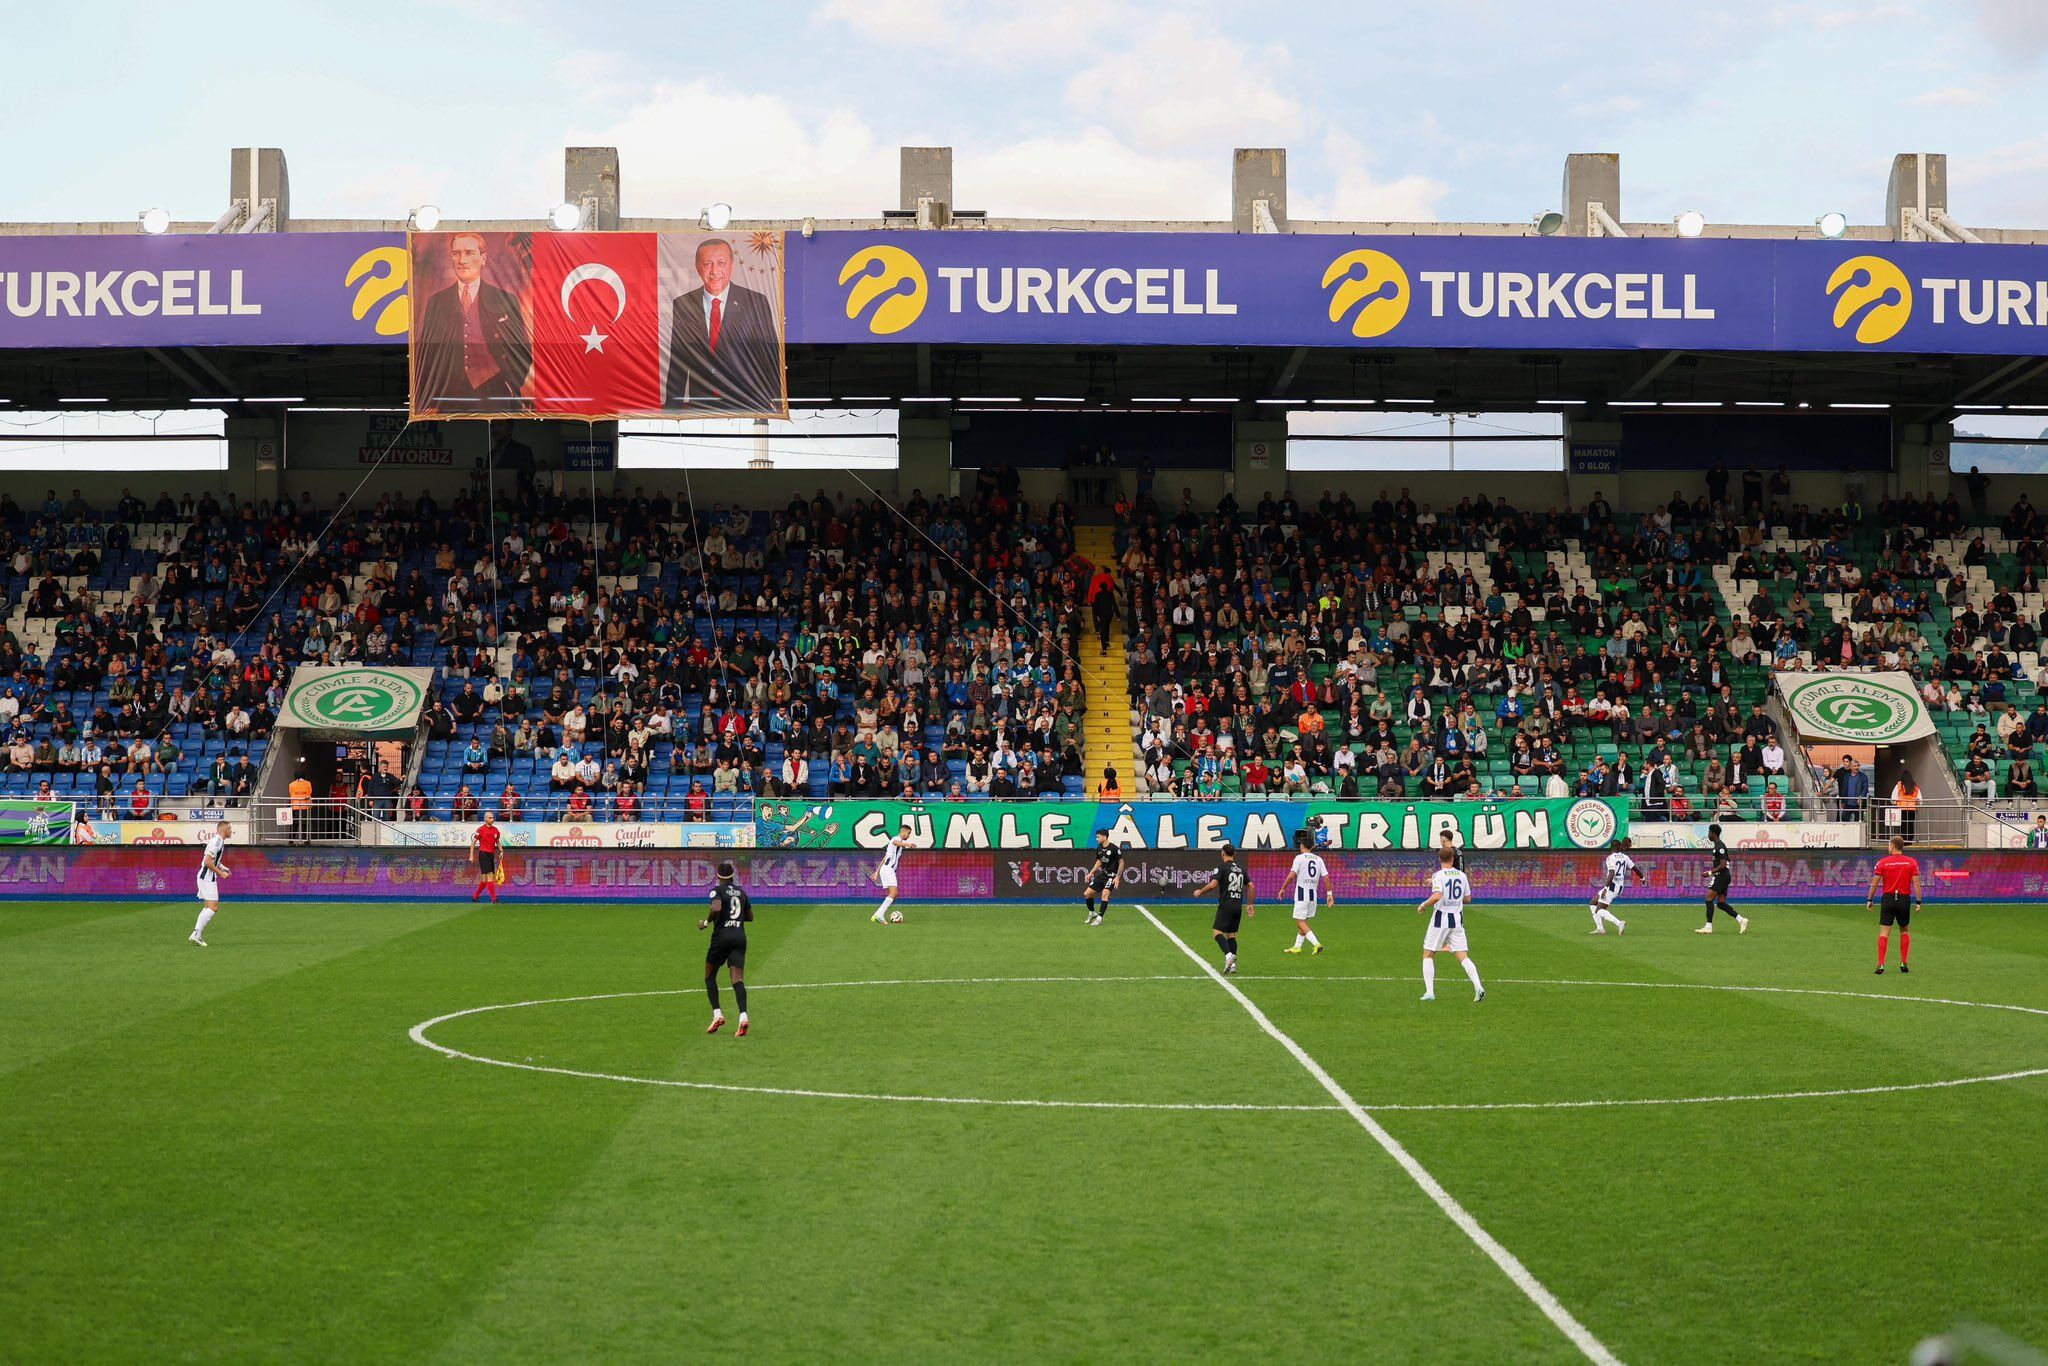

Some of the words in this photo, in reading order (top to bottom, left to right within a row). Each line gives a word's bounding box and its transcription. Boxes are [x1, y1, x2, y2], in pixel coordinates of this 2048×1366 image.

[0, 269, 262, 317] URKCELL
[938, 267, 1238, 315] TURKCELL
[1420, 271, 1716, 319] TURKCELL
[1921, 278, 2048, 326] TUR
[567, 446, 609, 454] MARATON
[1573, 449, 1616, 457] MARATON
[572, 459, 578, 467] C
[581, 459, 605, 467] BLOK
[1588, 462, 1611, 470] BLOK
[281, 811, 288, 821] 8
[854, 805, 1074, 849] CÜMLE
[1107, 802, 1287, 849] ÂLEM
[1320, 805, 1550, 850] TRİBÜN
[512, 859, 581, 886] JET
[1033, 862, 1147, 884] trenol
[1308, 860, 1317, 877] 6
[1615, 860, 1626, 876] 21
[1823, 859, 1953, 887] KAN
[1228, 872, 1244, 892] 20
[1445, 878, 1462, 900] 16
[729, 896, 741, 919] 9
